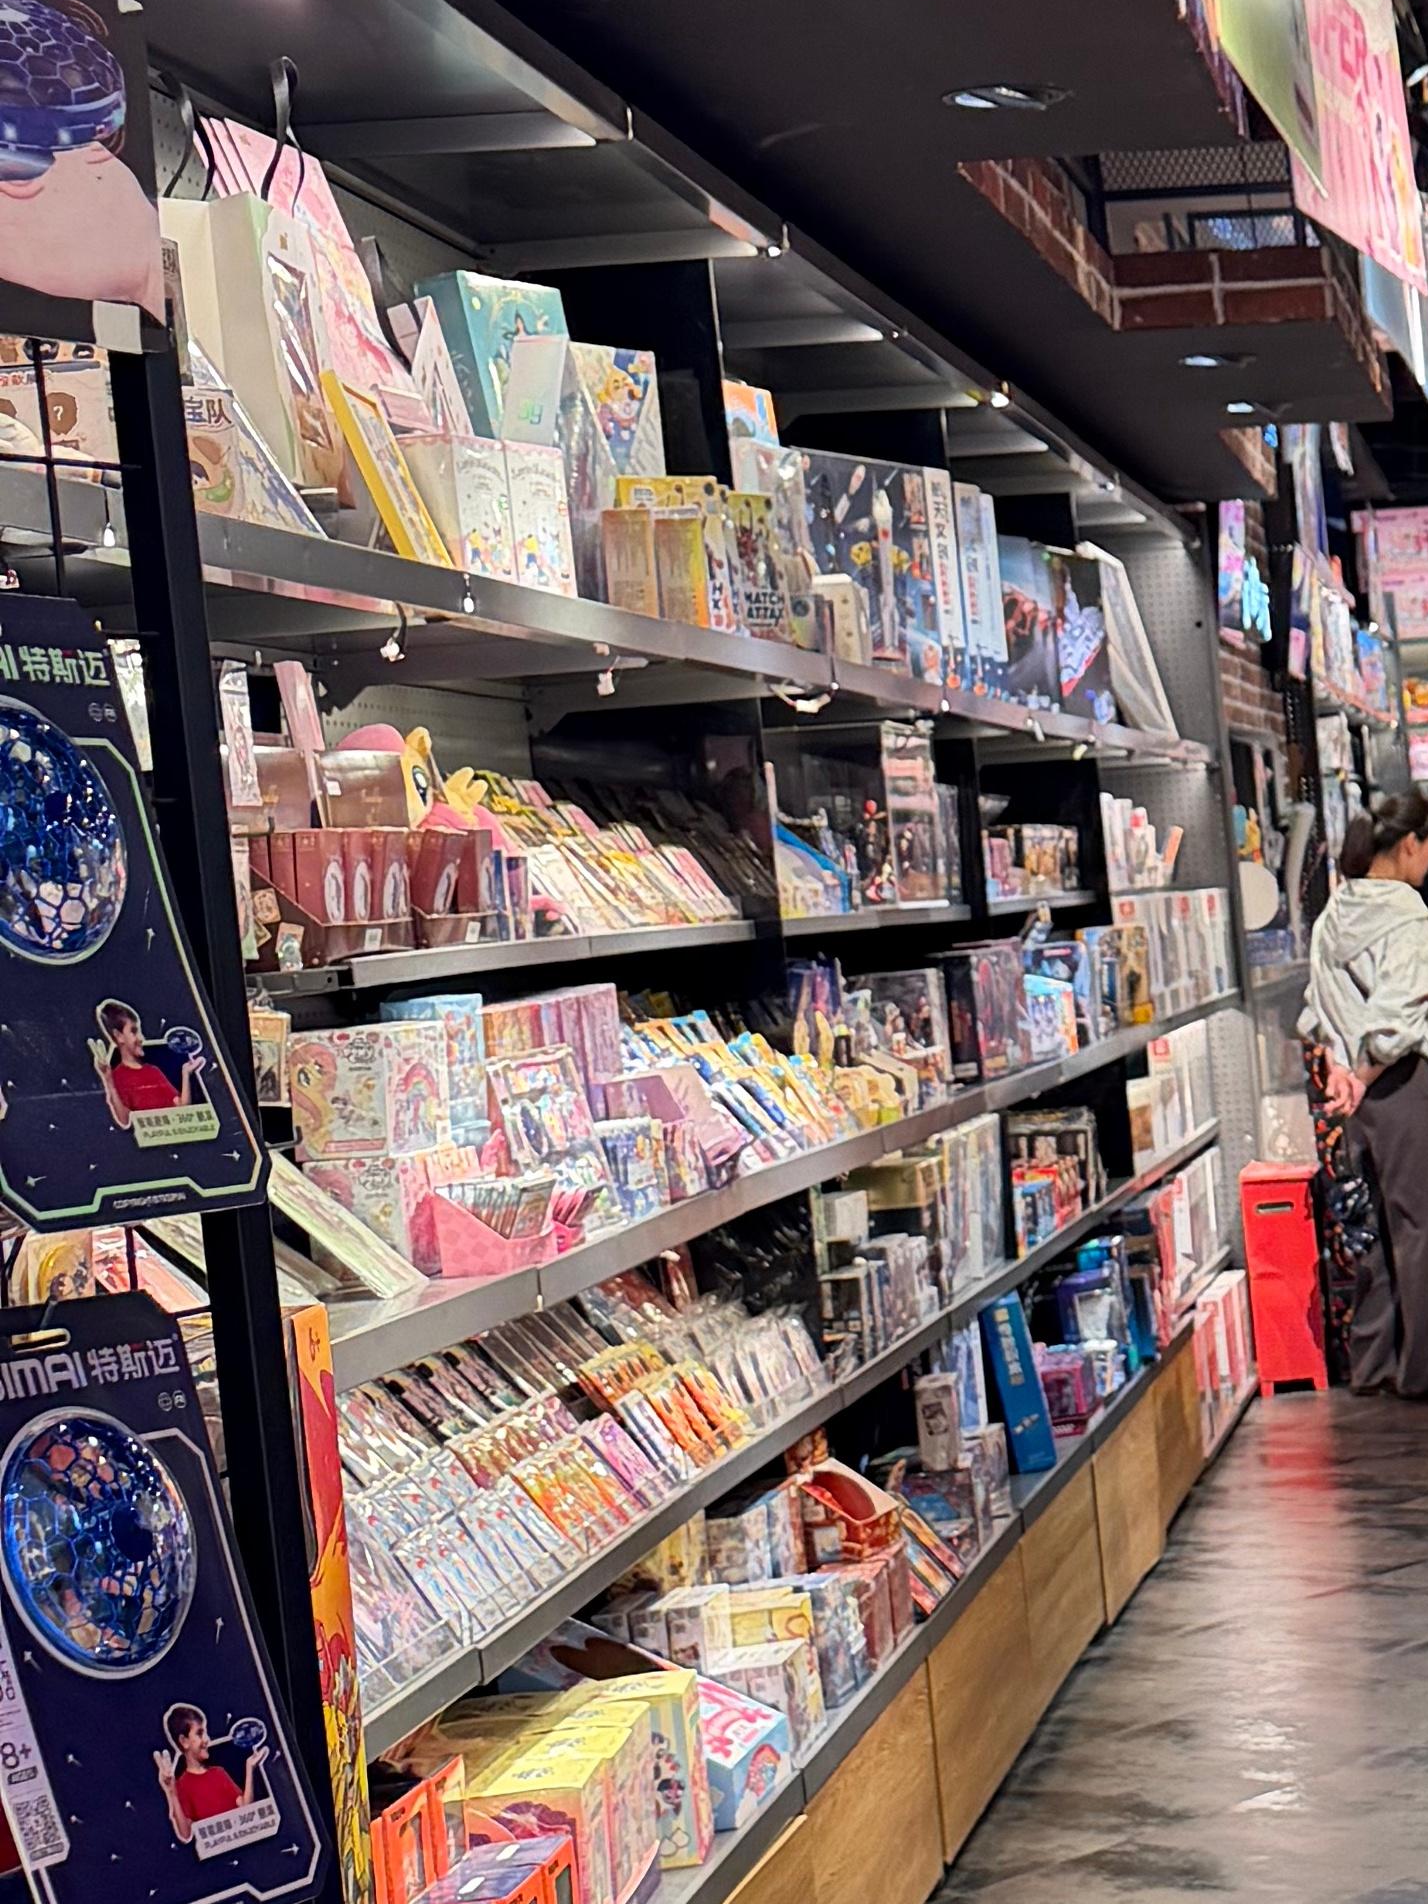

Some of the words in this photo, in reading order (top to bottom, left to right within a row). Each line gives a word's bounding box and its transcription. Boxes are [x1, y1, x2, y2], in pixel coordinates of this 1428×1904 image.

[18, 645, 111, 686] 特斯迈
[86, 1337, 181, 1386] 特斯迈
